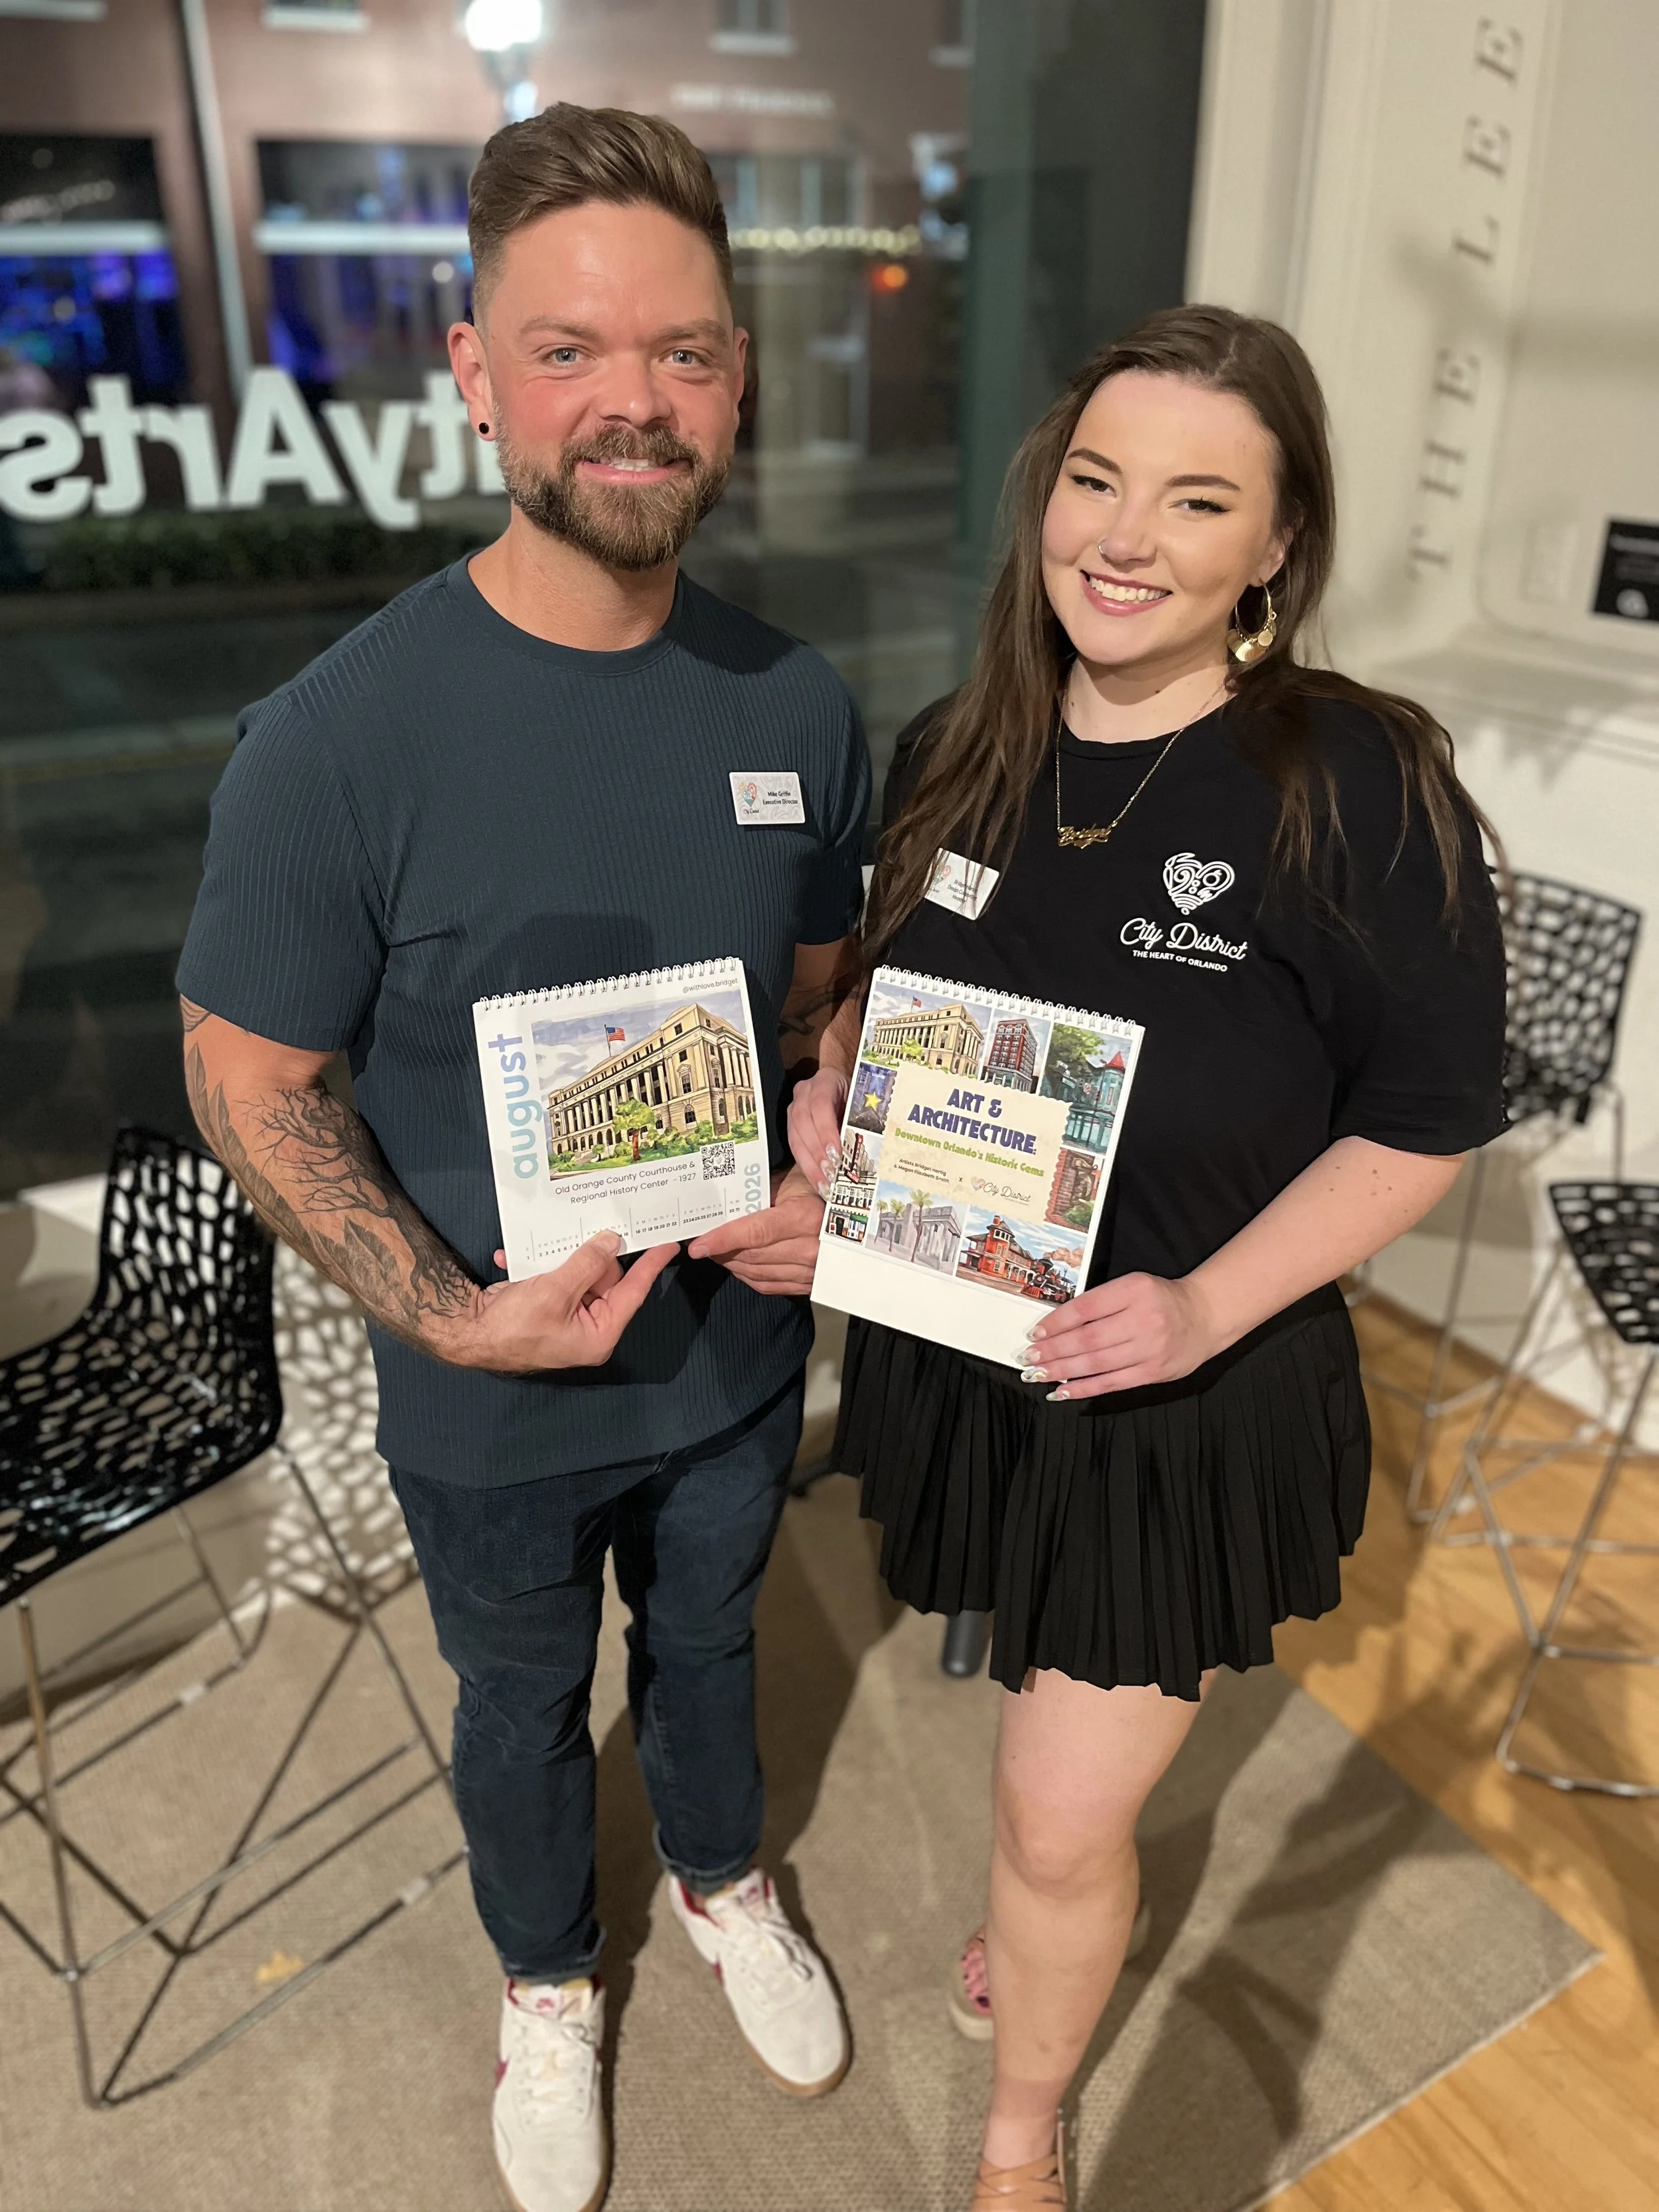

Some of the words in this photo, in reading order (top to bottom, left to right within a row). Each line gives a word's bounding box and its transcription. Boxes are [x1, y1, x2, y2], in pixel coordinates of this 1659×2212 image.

[1405, 346, 1481, 584] THE
[1451, 16, 1525, 270] LEE
[1119, 917, 1164, 950] City
[1166, 922, 1248, 960] District
[1132, 950, 1148, 959] THE
[1149, 952, 1175, 960] HEART
[1188, 958, 1228, 972] ORLANDO
[683, 978, 739, 994] @withlove.bridget
[488, 1033, 543, 1179] august
[946, 1088, 985, 1114] ART
[987, 1098, 1003, 1118] &
[906, 1103, 1037, 1155] ARCHITECTURE:
[894, 1127, 942, 1149] Downtown
[942, 1140, 983, 1160] Orlando's
[985, 1152, 1018, 1170] Historic
[1020, 1163, 1045, 1177] Gems
[555, 1185, 570, 1195] Old
[572, 1179, 604, 1191] Orange
[606, 1173, 637, 1184] County
[639, 1163, 687, 1177] Courthouse
[571, 1190, 608, 1204] Regional
[610, 1185, 638, 1195] History
[640, 1179, 669, 1190] Center
[679, 1173, 696, 1182] 1927
[744, 1163, 762, 1215] 2026
[914, 1169, 935, 1179] Elizabeth
[983, 1182, 999, 1196] City
[1000, 1186, 1031, 1203] District
